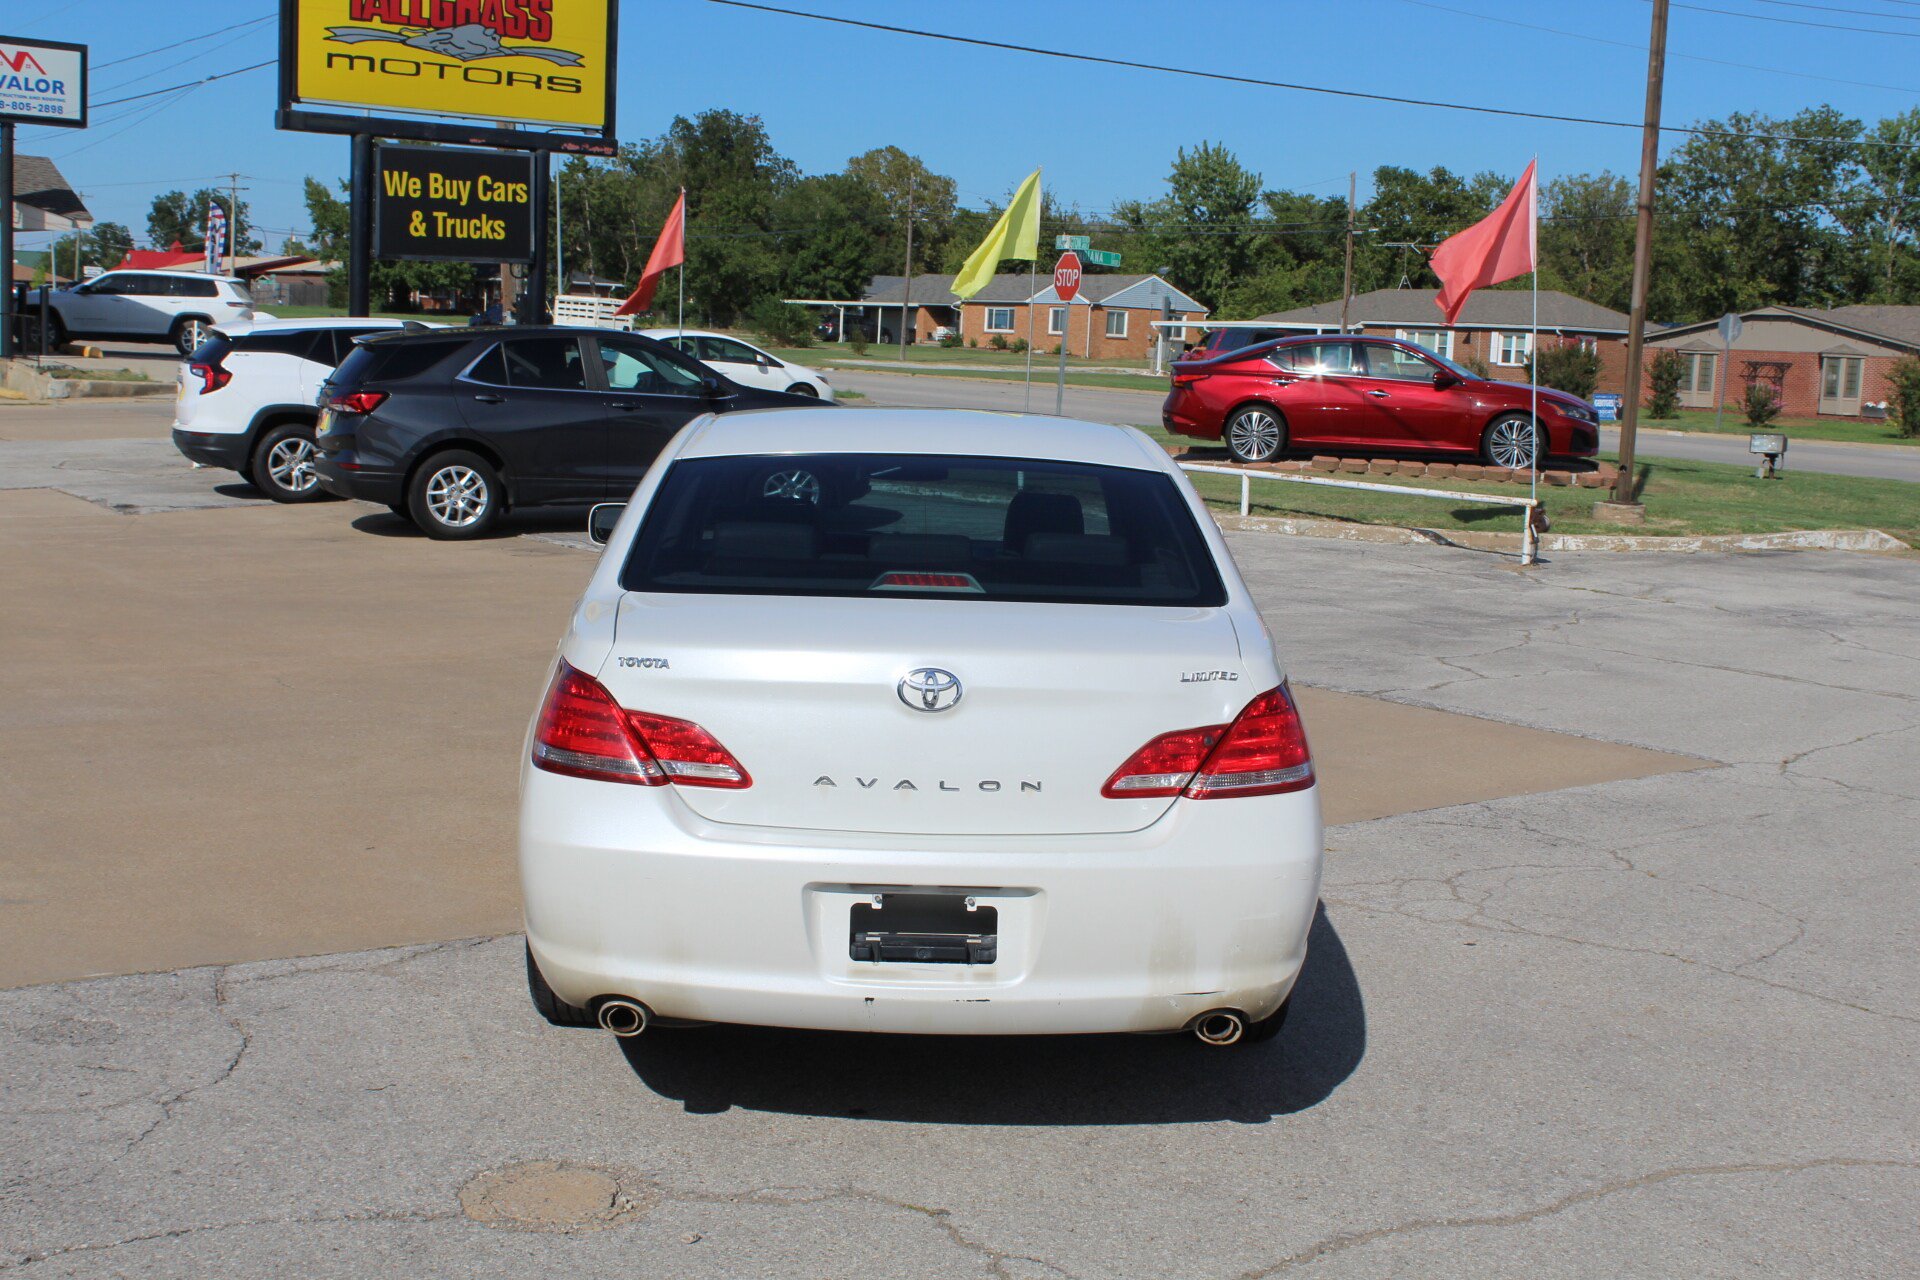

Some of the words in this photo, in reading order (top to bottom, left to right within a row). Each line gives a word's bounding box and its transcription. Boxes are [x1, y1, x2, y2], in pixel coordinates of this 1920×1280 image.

[326, 52, 582, 94] MOTORS
[383, 170, 421, 198] We
[429, 172, 471, 206] Buy
[477, 175, 528, 203] Cars
[409, 210, 427, 237] &
[432, 211, 506, 240] Trucks
[1056, 269, 1079, 286] STOP
[618, 656, 670, 669] TOYOTA
[1180, 671, 1238, 682] LIMITED
[812, 775, 1042, 792] AVALON
